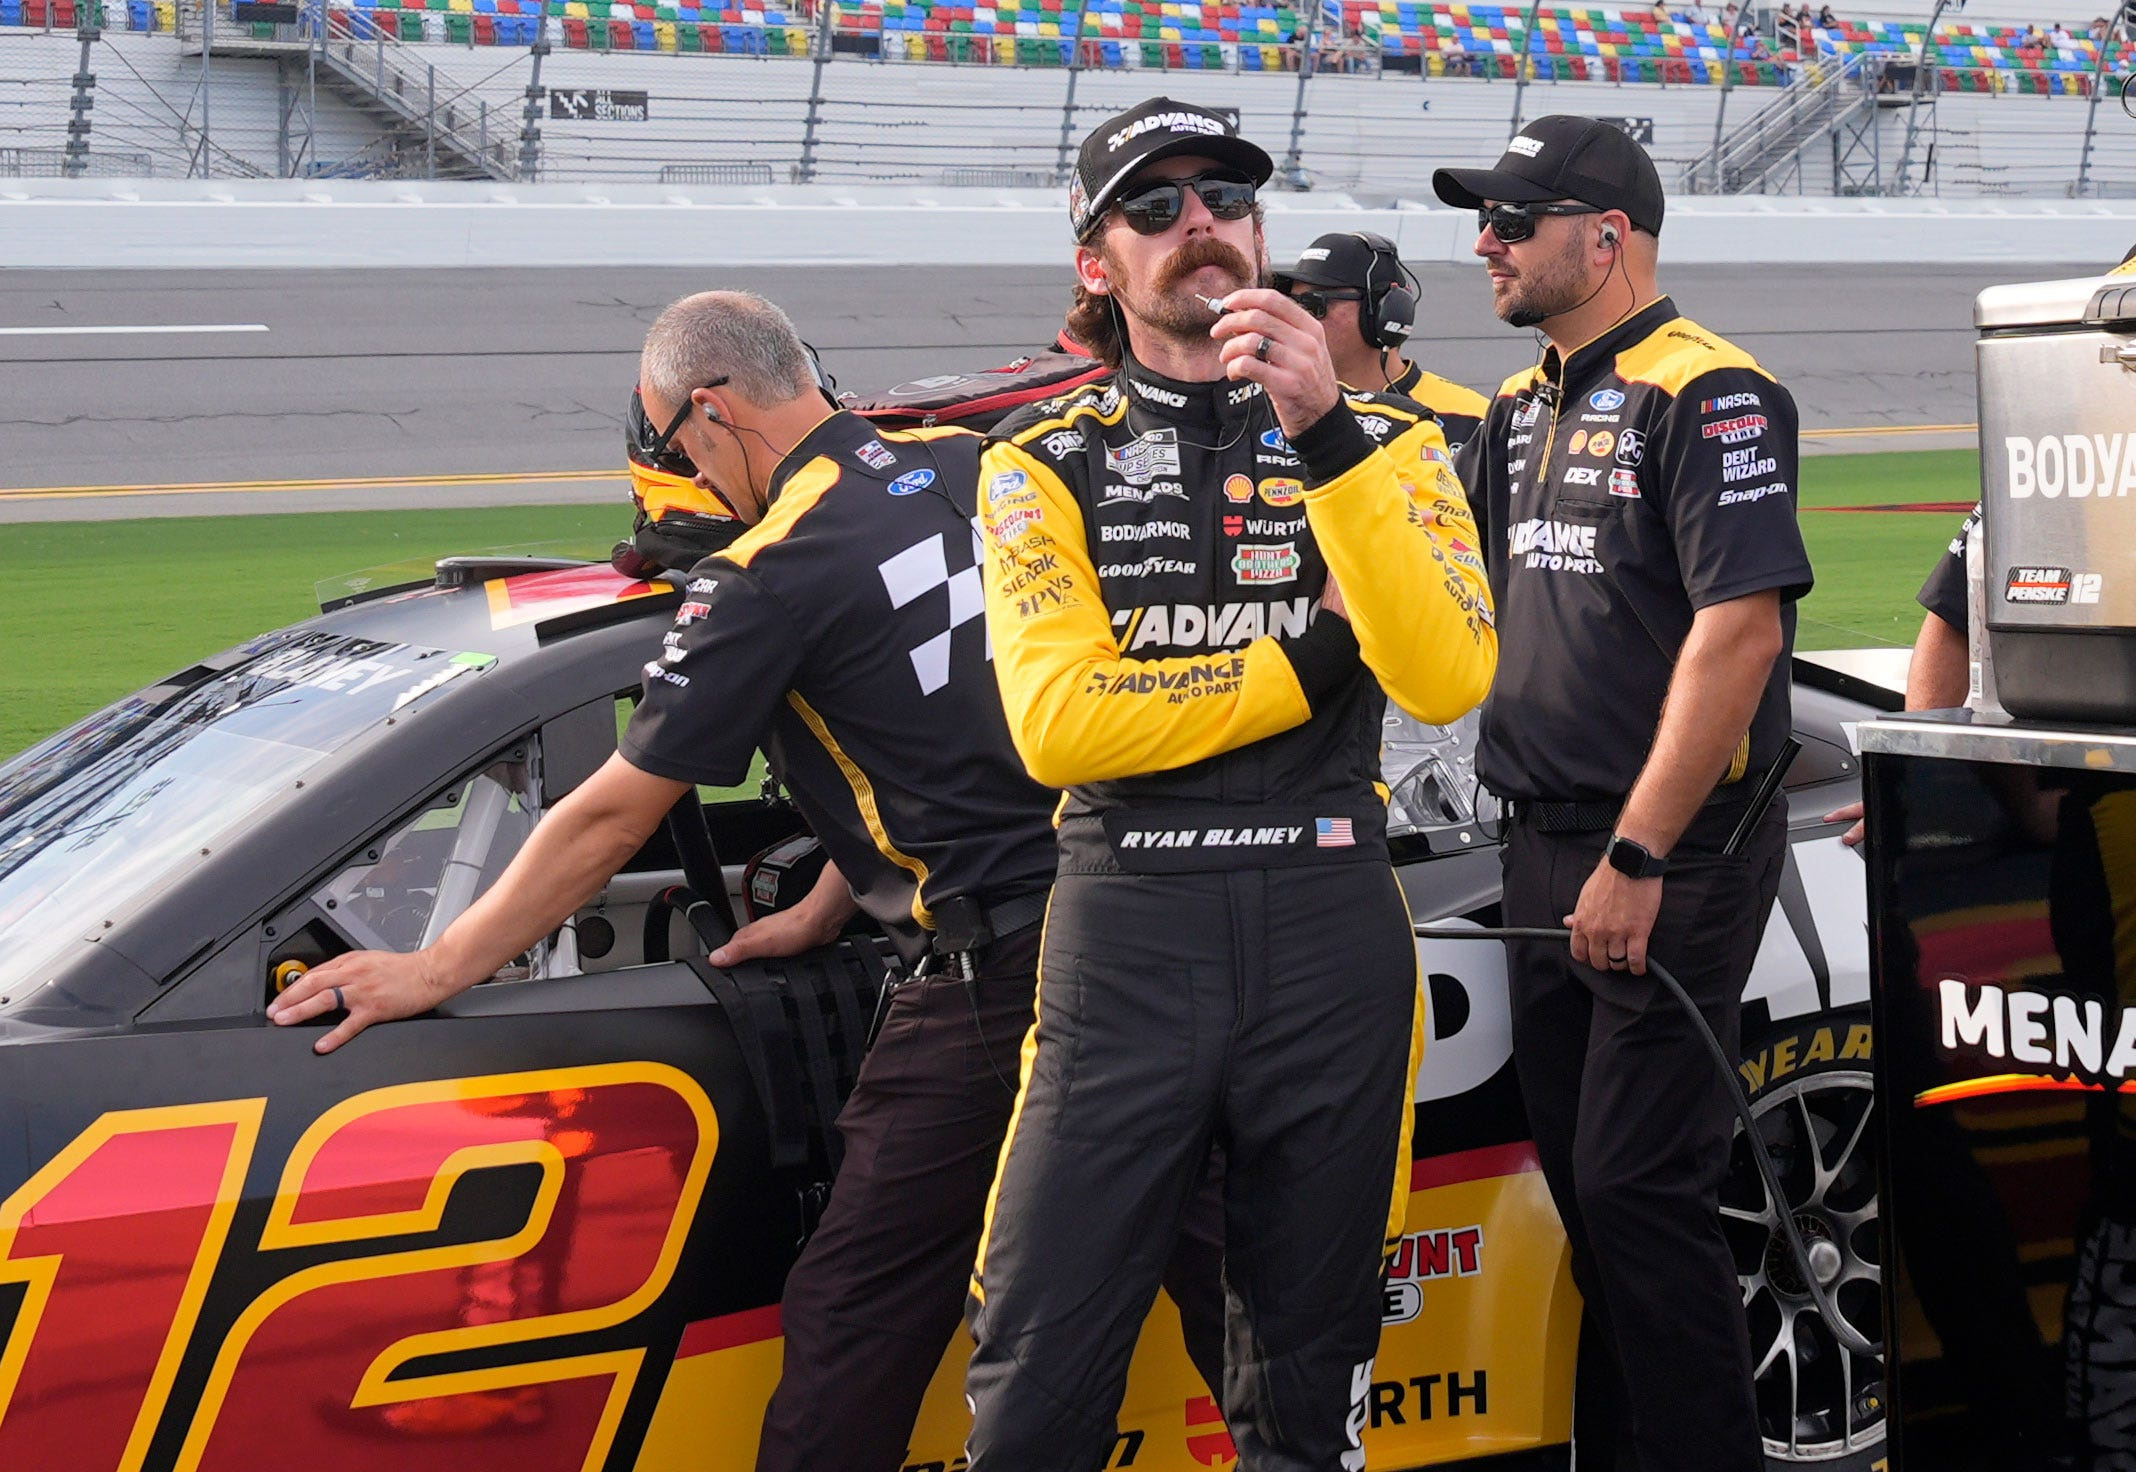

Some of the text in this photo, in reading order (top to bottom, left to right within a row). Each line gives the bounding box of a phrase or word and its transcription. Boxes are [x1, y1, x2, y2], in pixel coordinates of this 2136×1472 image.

[595, 90, 613, 105] ALL
[594, 105, 645, 120] SECTIONS
[1129, 379, 1188, 408] DVANCE
[1718, 392, 1762, 411] NASCAR
[1581, 414, 1619, 423] RACING
[1722, 446, 1758, 468] DENT
[1564, 467, 1603, 486] DEX
[1722, 458, 1777, 482] WIZARD
[1105, 482, 1183, 504] MENARDS
[1264, 485, 1300, 497] PENNZOIL
[1718, 483, 1787, 506] Snap-on
[1101, 520, 1191, 542] BODYARMOR
[1246, 515, 1307, 537] WÜRTH
[1238, 557, 1294, 569] BROTHERS
[1250, 550, 1283, 560] HUNT
[1099, 556, 1197, 578] GOODYEAR
[1250, 569, 1283, 579] PIZZA
[2018, 568, 2062, 583] TEAM
[2007, 586, 2067, 602] PENSKE
[2071, 573, 2103, 604] 12
[1117, 658, 1245, 694] ADVANCE
[1205, 680, 1245, 705] PART
[1121, 826, 1303, 849] RYAN BLANEY
[0, 1060, 720, 1472] 12
